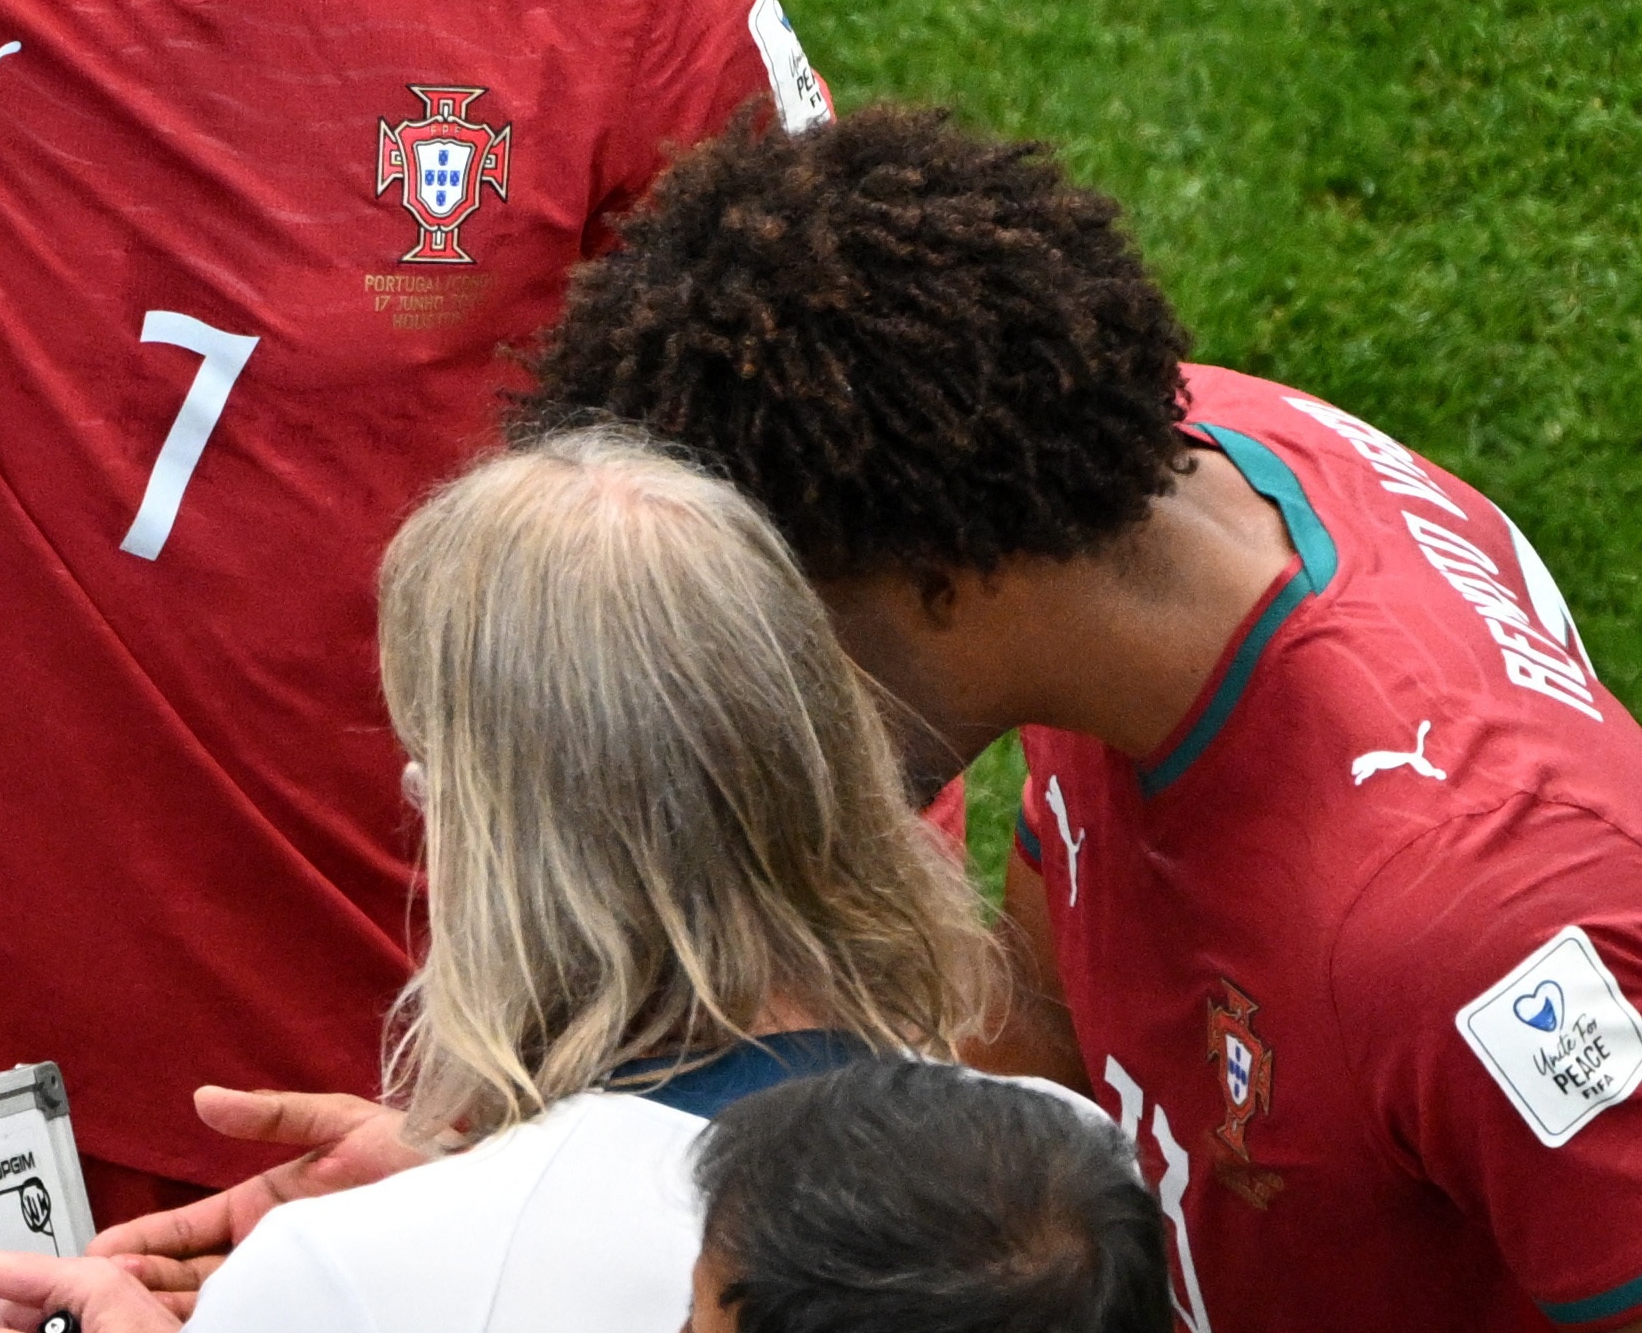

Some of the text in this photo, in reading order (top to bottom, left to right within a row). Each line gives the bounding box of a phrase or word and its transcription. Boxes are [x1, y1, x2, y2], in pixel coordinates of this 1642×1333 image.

[374, 294, 391, 312] 17
[119, 310, 261, 561] 7
[1533, 1012, 1599, 1077] Unite For
[1552, 1035, 1611, 1096] PEACE
[1581, 1073, 1615, 1100] FIFA
